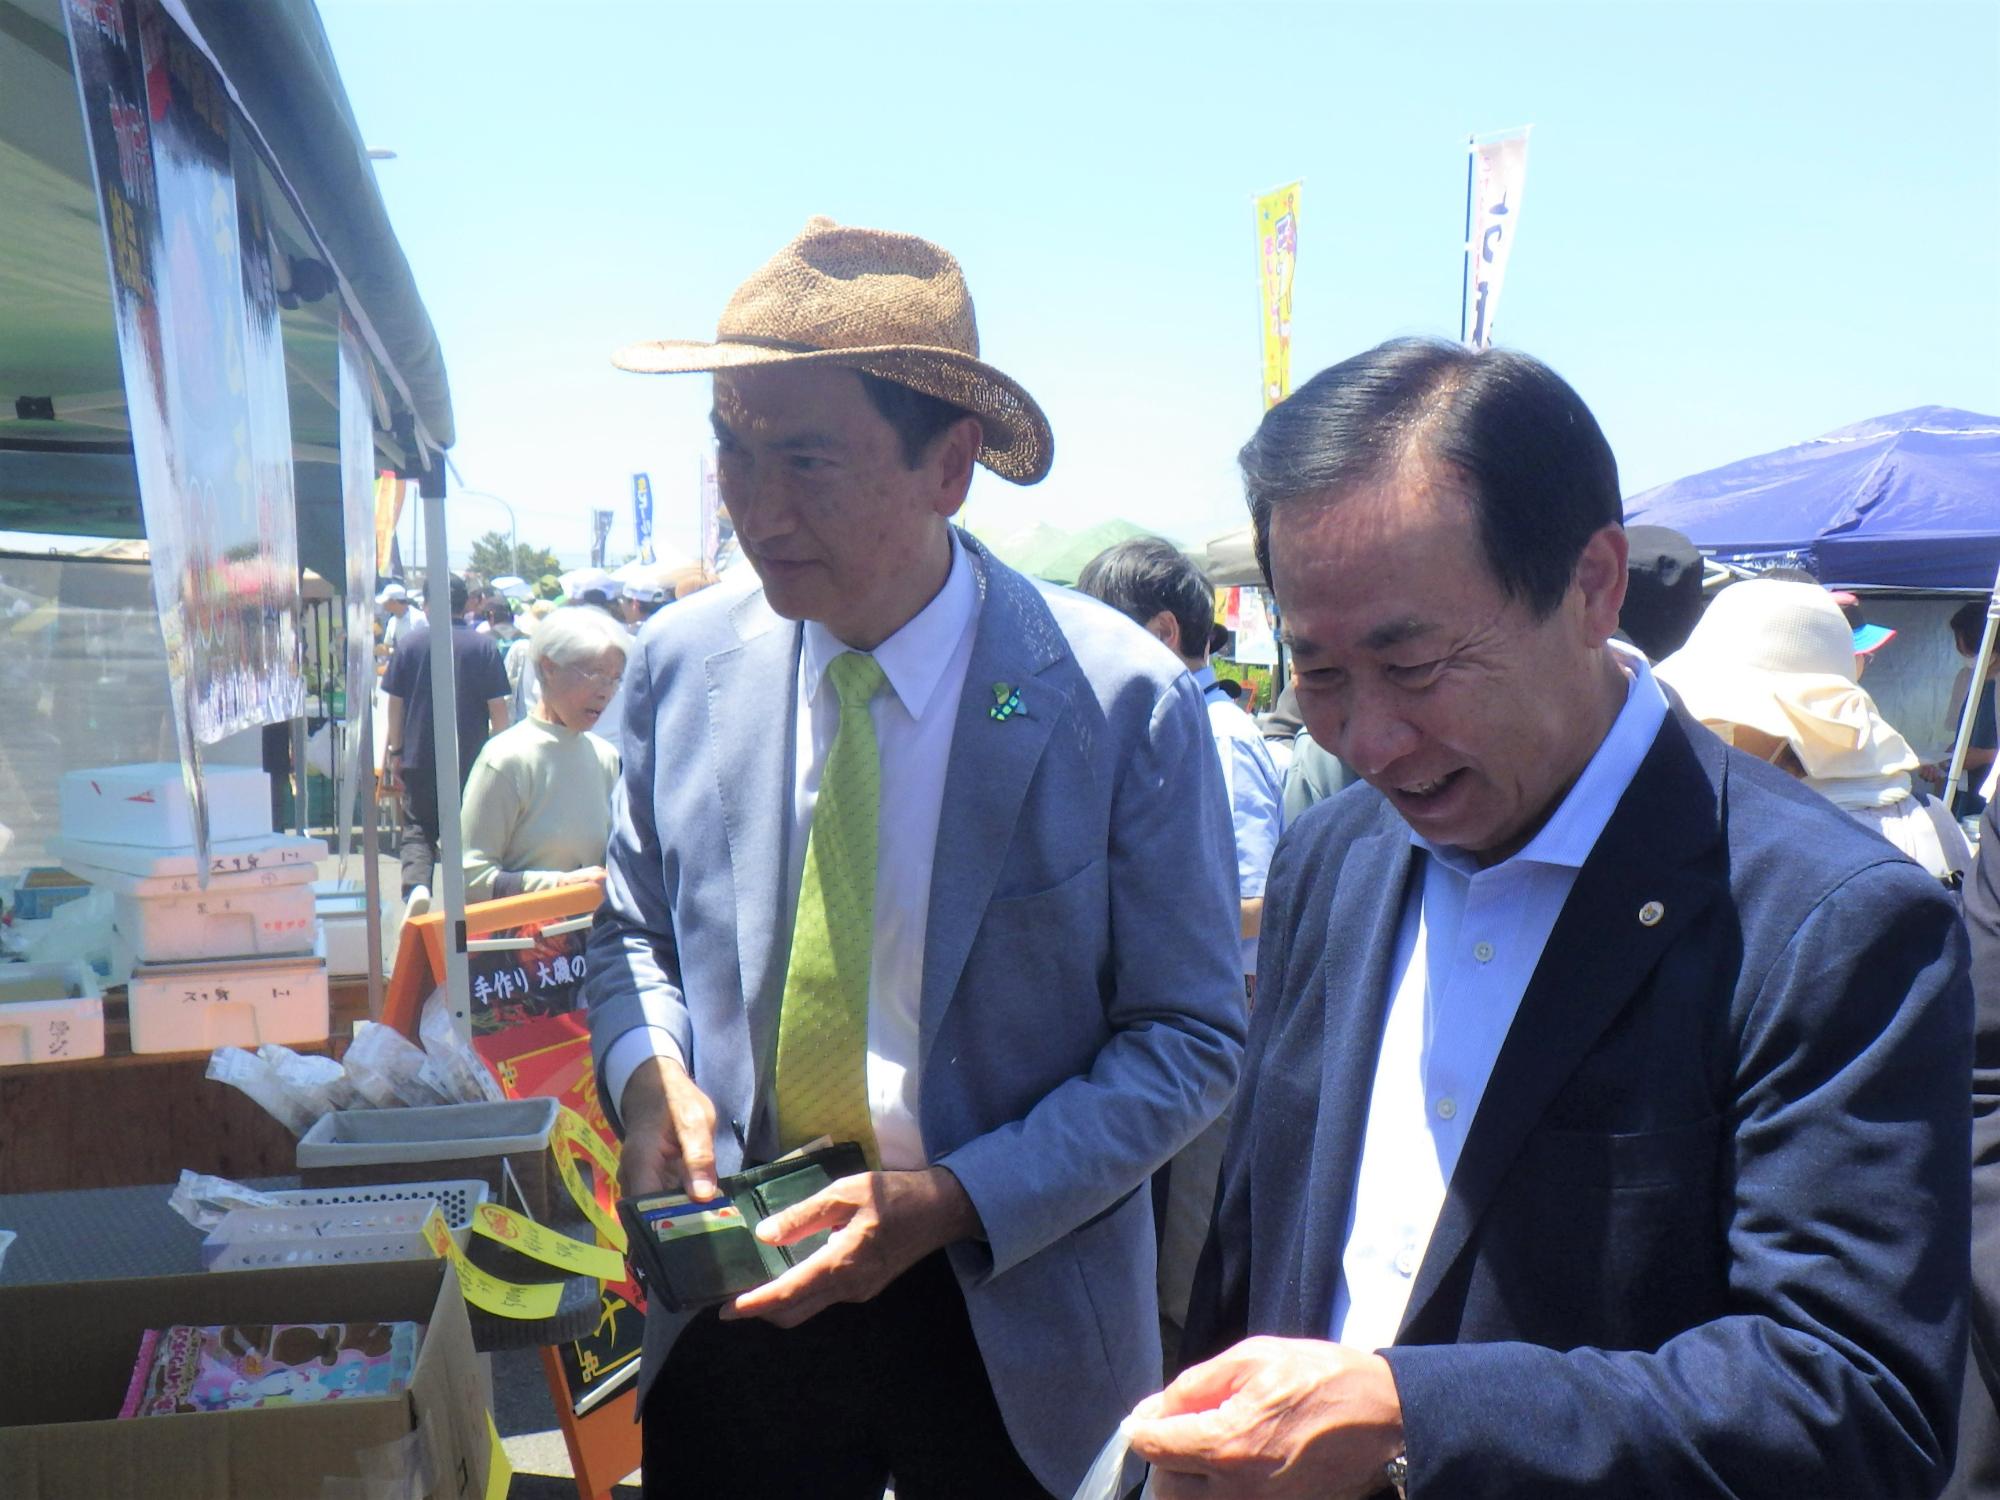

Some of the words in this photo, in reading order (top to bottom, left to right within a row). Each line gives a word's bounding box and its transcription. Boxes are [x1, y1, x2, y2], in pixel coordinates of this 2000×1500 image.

[474, 967, 529, 1006] 手作り
[536, 954, 588, 989] 大磯の
